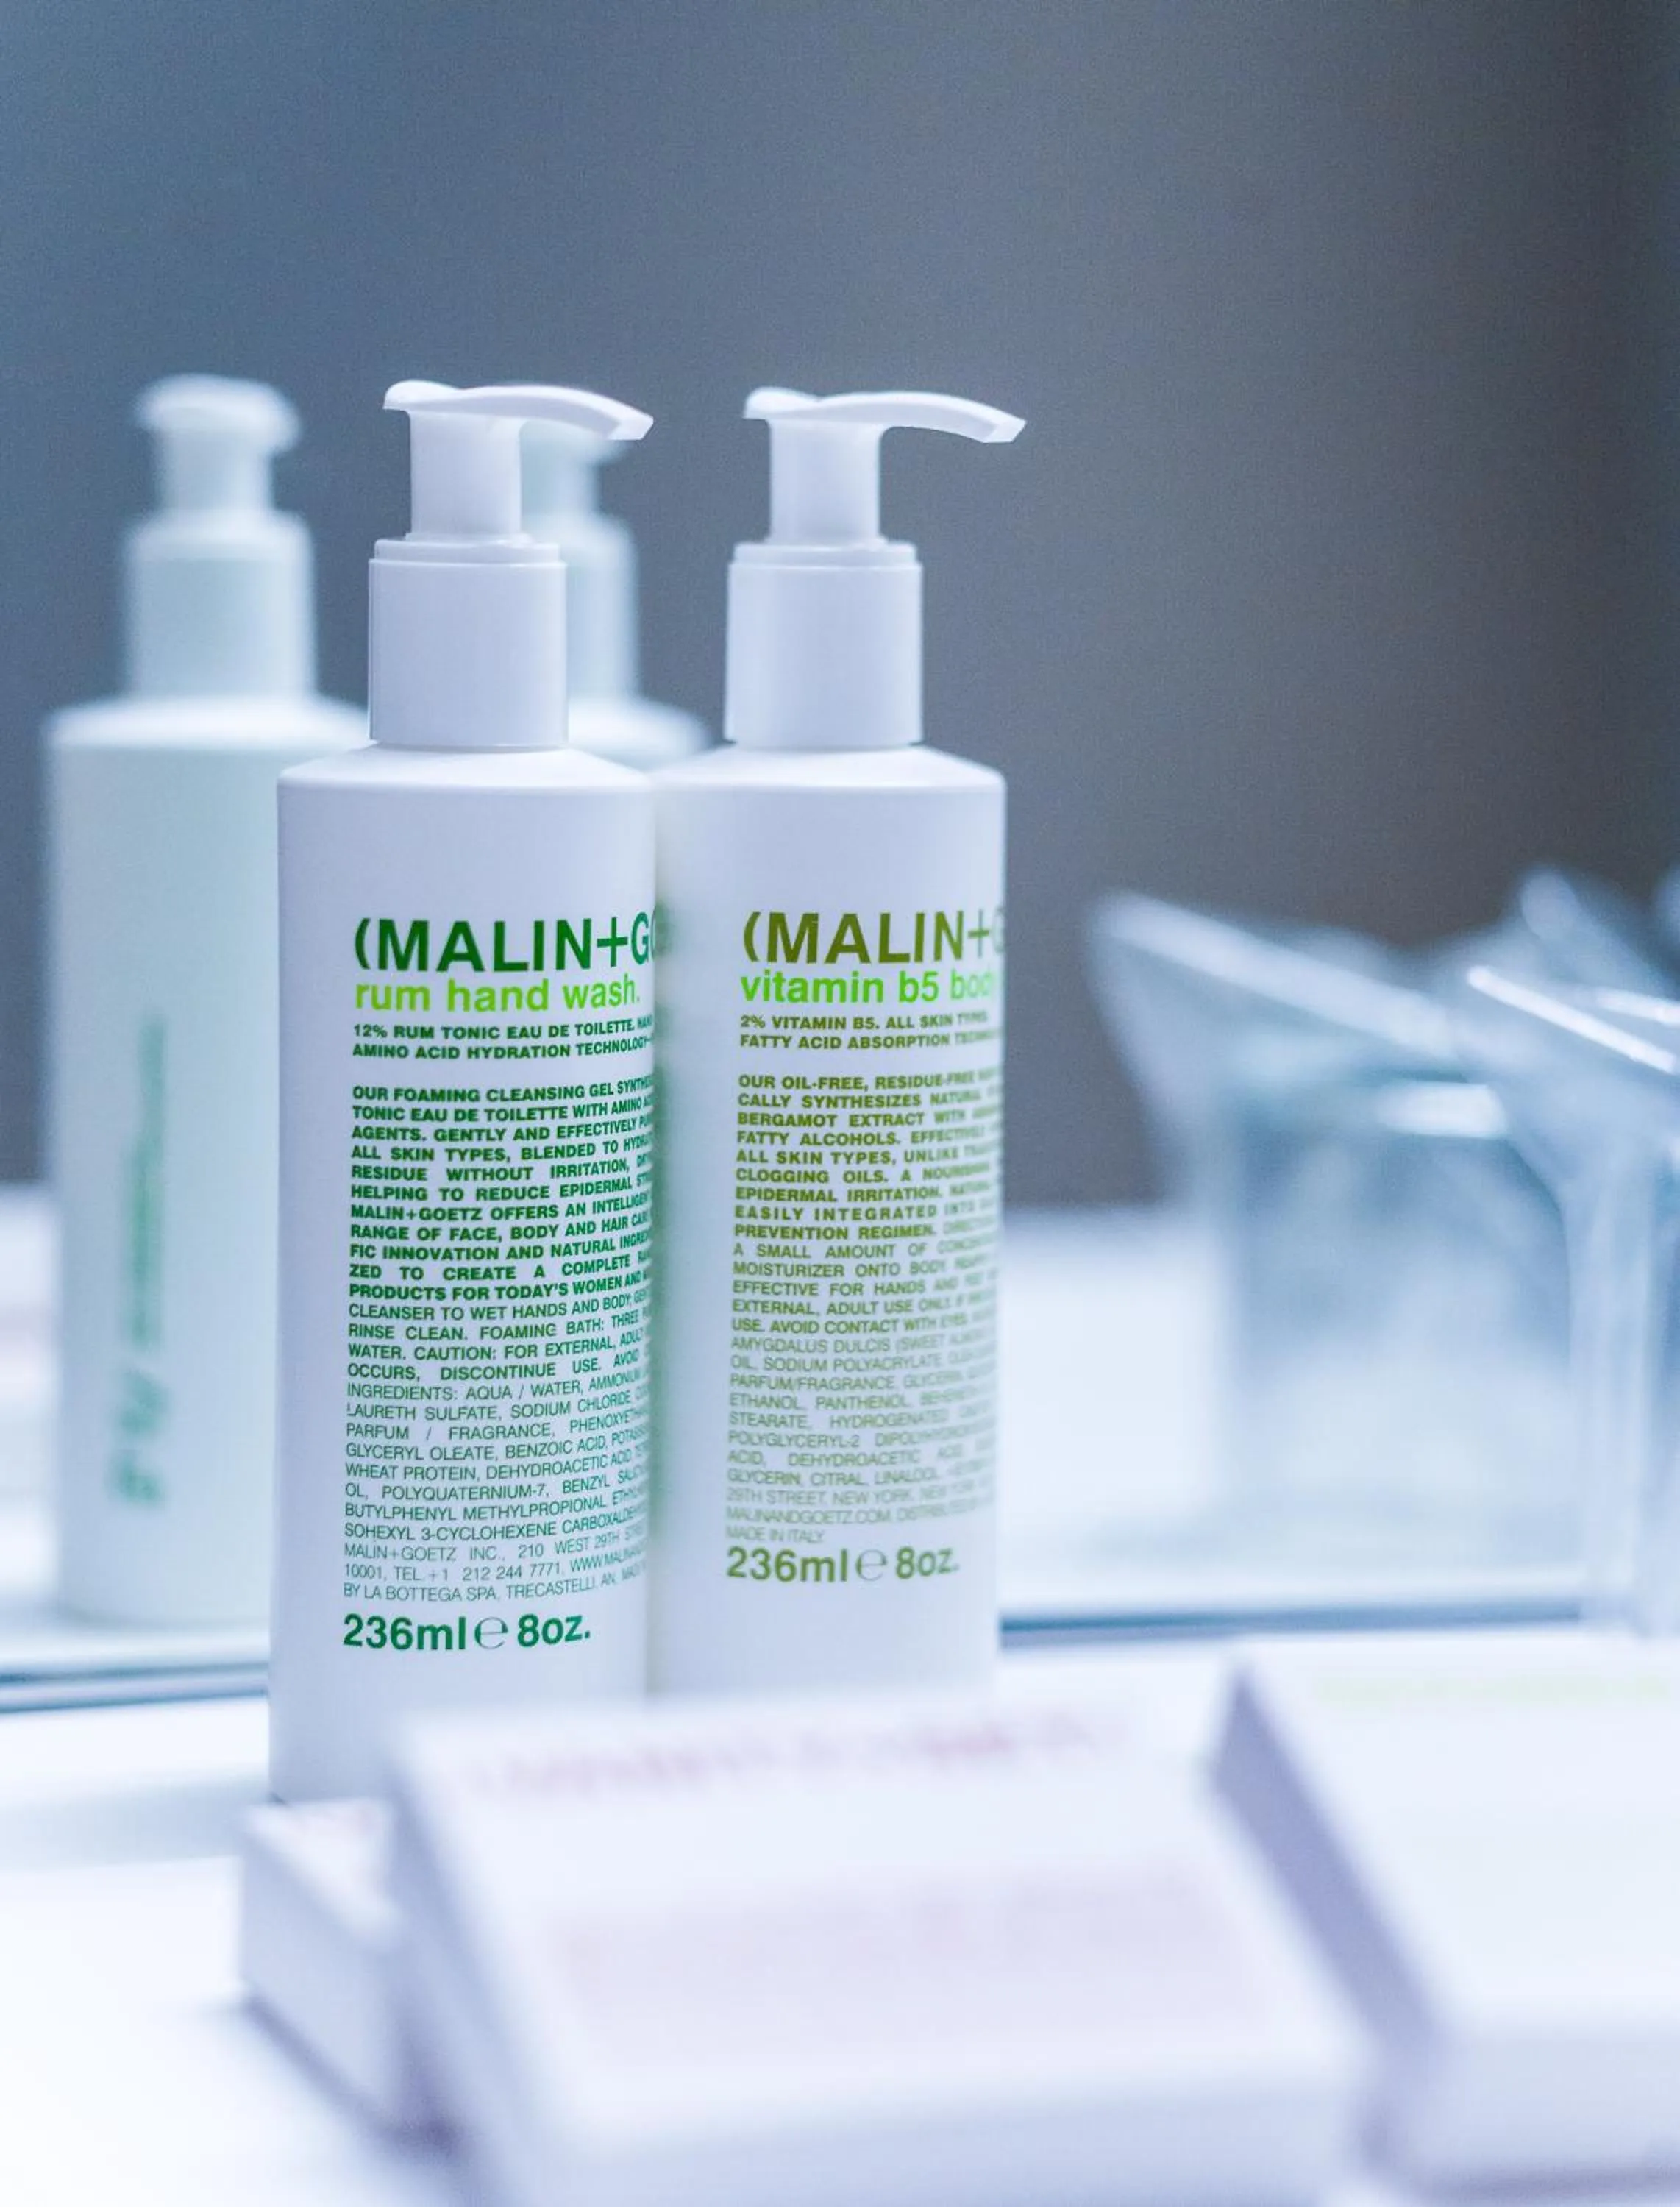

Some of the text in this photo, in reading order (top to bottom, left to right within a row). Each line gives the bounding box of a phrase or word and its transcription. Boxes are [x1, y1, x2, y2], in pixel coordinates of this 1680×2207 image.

[355, 912, 656, 972] (MALIN+G
[357, 973, 640, 1012] rum hand wash.
[741, 970, 883, 1003] vitamin
[899, 971, 939, 1003] b5
[741, 1014, 766, 1028] 2%
[772, 1016, 846, 1030] VITAMIN
[886, 1016, 914, 1029] ALL
[919, 1014, 953, 1028] SKIN
[354, 1024, 388, 1038] 12%
[394, 1026, 435, 1039] RUM
[441, 1026, 500, 1040] TONIC
[507, 1026, 541, 1039] EAU
[548, 1024, 569, 1038] DE
[741, 1034, 792, 1048] FATTY
[798, 1036, 841, 1049] ACID
[847, 1034, 950, 1049] ABSORPTION
[353, 1043, 571, 1059] AMINO ACID HYDRATION
[738, 1074, 775, 1089] OUR
[352, 1083, 614, 1103] OUR FOAMING CLEANSING GEL
[738, 1093, 921, 1109] CALLY SYNTHESIZES
[352, 1105, 405, 1121] TONIC
[410, 1108, 448, 1122] EAU
[454, 1109, 478, 1122] DE
[484, 1106, 568, 1122] TOILETTE
[572, 1102, 608, 1118] WITH
[738, 1112, 924, 1127] BERGAMOT EXTRACT
[352, 1126, 427, 1142] AGENTS.
[433, 1128, 507, 1142] GENTLY
[513, 1127, 550, 1141] AND
[556, 1117, 637, 1139] EFFECTIVELY
[737, 1130, 789, 1145] FATTY
[351, 1140, 619, 1163] ALL SKIN TYPES, BLENDED TO
[736, 1149, 769, 1163] ALL
[777, 1151, 822, 1165] SKIN
[352, 1165, 427, 1181] RESIDUE
[446, 1167, 534, 1181] WITHOUT
[736, 1168, 829, 1184] CLOGGING
[900, 1169, 911, 1181] A
[351, 1176, 633, 1201] HELPING TO REDUCE EPIDERMAL
[736, 1187, 838, 1202] EPIDERMAL
[351, 1202, 586, 1221] MALIN+GOETZ OFFERS AN
[735, 1205, 936, 1221] EASILY INTEGRATED
[351, 1216, 628, 1243] RANGE OF FACE, BODY AND HAIR
[735, 1224, 848, 1240] PREVENTION
[350, 1237, 616, 1261] FIC INNOVATION AND NATURAL
[733, 1243, 895, 1259] A SMALL AMOUNT
[349, 1263, 382, 1279] ZED
[399, 1266, 424, 1281] TO
[443, 1266, 516, 1281] CREATE
[533, 1265, 545, 1278] A
[562, 1258, 630, 1276] COMPLETE
[733, 1261, 901, 1278] MOISTURIZER ONTO
[349, 1275, 622, 1301] PRODUCTS FOR TODAY'S WOMEN
[349, 1298, 599, 1321] CLEANSER TO WET HANDS AND
[349, 1323, 394, 1339] RINSE
[406, 1326, 468, 1341] CLEAN.
[480, 1323, 556, 1340] FOAMING
[348, 1343, 406, 1360] WATER.
[504, 1344, 538, 1360] FOR
[441, 1362, 556, 1381] DISCONTINUE
[465, 1385, 513, 1401] AQUA
[346, 1403, 416, 1421] LAURETH
[510, 1401, 571, 1420] SODIUM
[346, 1422, 409, 1440] PARFUM
[346, 1440, 573, 1460] GLYCERYL BENZOIC
[346, 1456, 607, 1480] WHEAT DEHYDROACETIC
[562, 1474, 610, 1494] BENZYL
[345, 1496, 606, 1521] BUTYLPHENYL METHYLPROPIONAL
[344, 1520, 557, 1541] SOHEXYL 3-CYCLOHEXENE
[344, 1542, 457, 1562] MALIN+GOETZ
[518, 1543, 544, 1559] 210
[554, 1536, 591, 1554] WEST
[462, 1565, 491, 1582] 212
[496, 1565, 522, 1580] 244
[344, 1582, 463, 1602] BY LA BOTTEGA
[344, 1613, 466, 1651] 236ml
